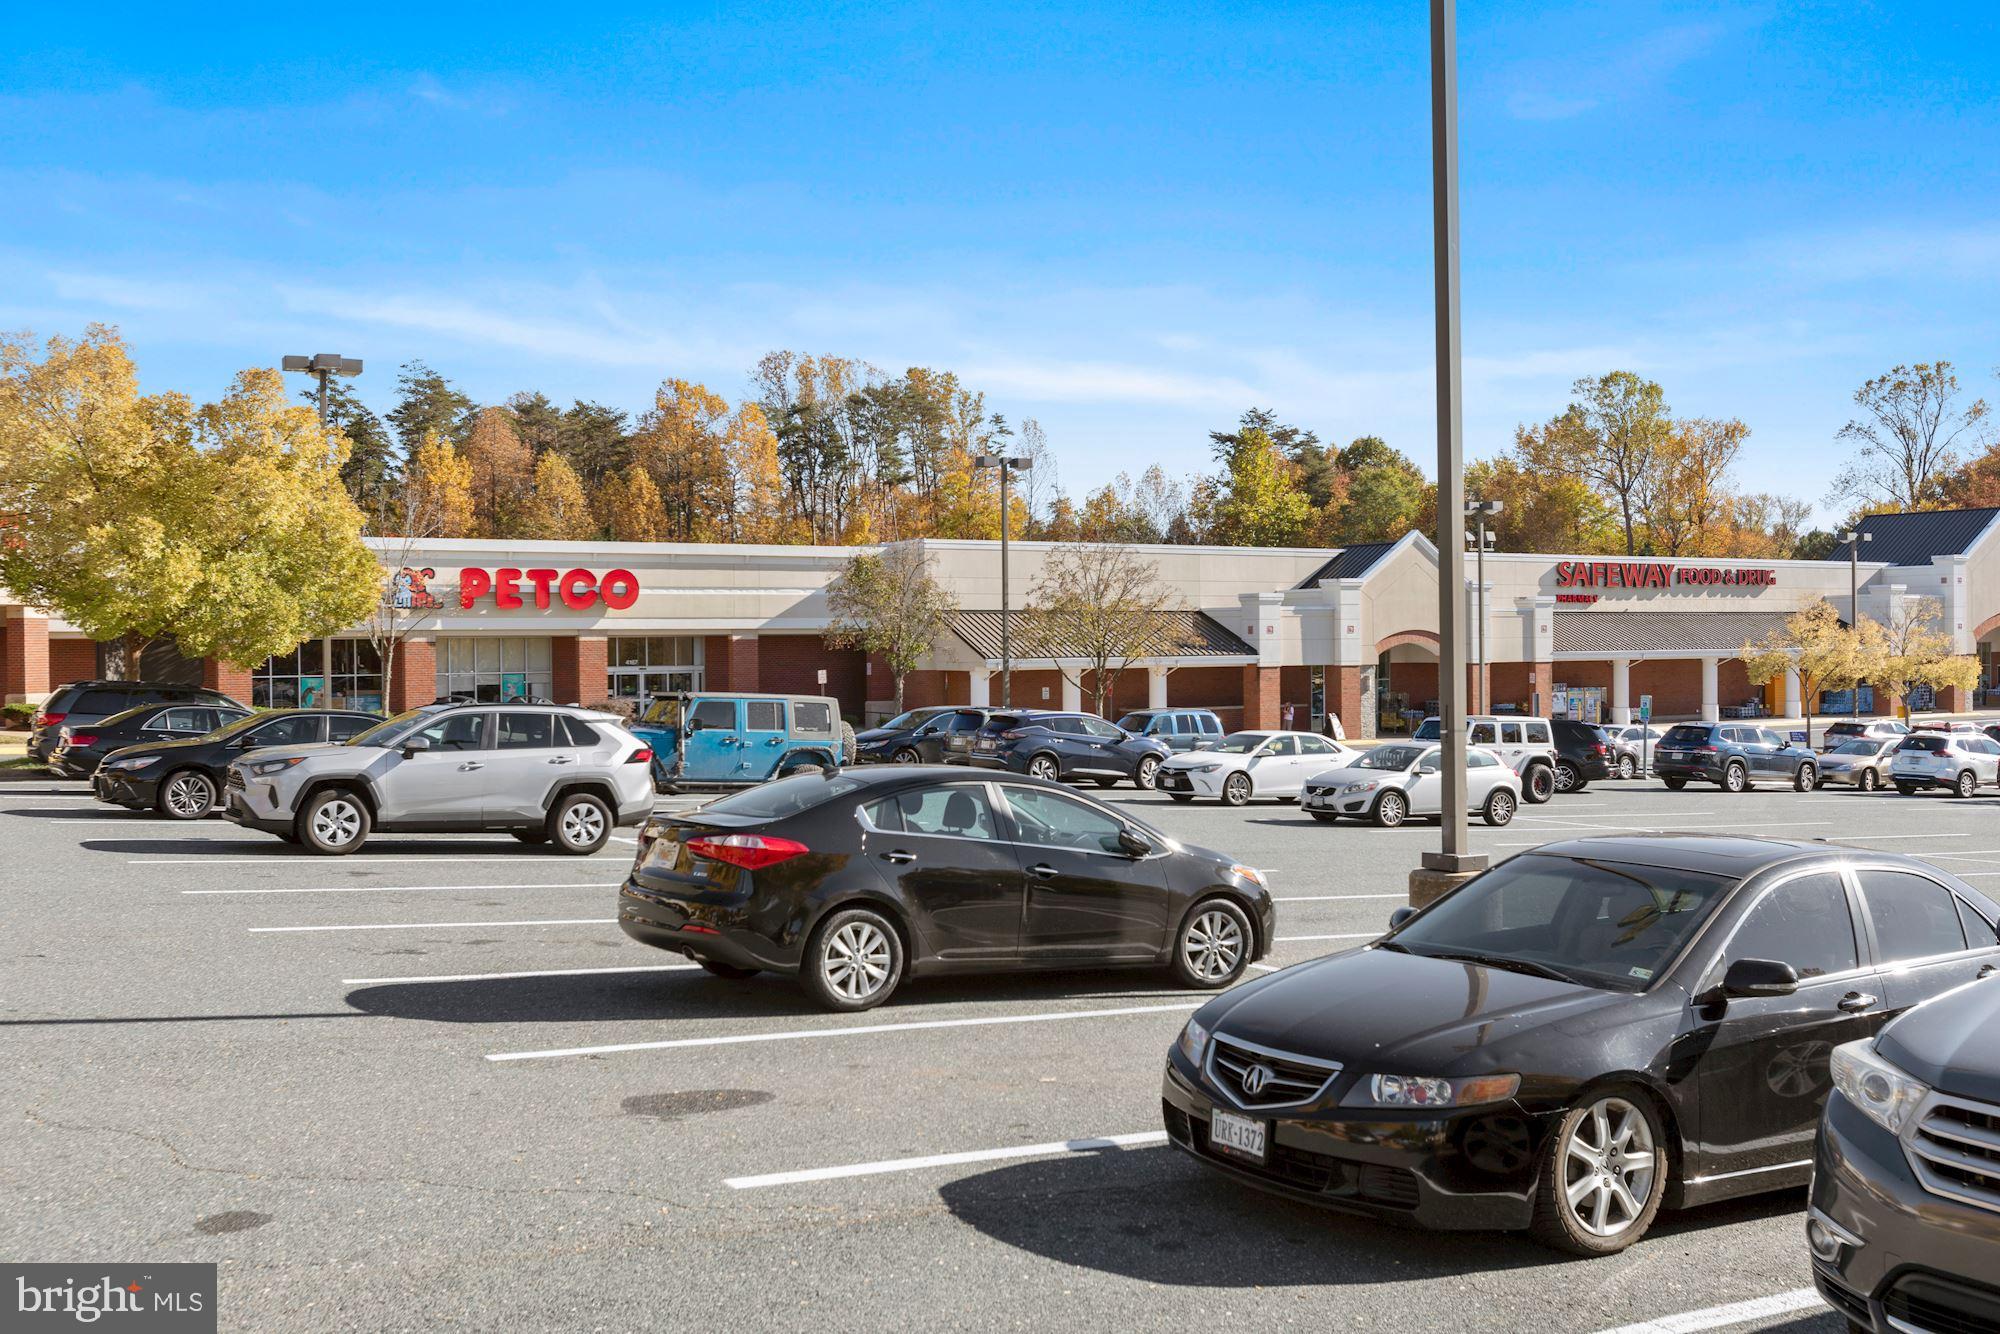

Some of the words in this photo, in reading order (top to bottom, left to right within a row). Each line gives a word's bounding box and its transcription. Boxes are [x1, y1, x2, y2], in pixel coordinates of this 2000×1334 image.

[460, 567, 639, 610] PETCO
[1556, 561, 1675, 588] SAFEWAY
[1677, 568, 1722, 585] FOOD
[1724, 569, 1736, 584] &
[1738, 569, 1777, 586] DRUG
[1556, 594, 1598, 603] PHARMAY
[1214, 1118, 1264, 1151] URK-1372
